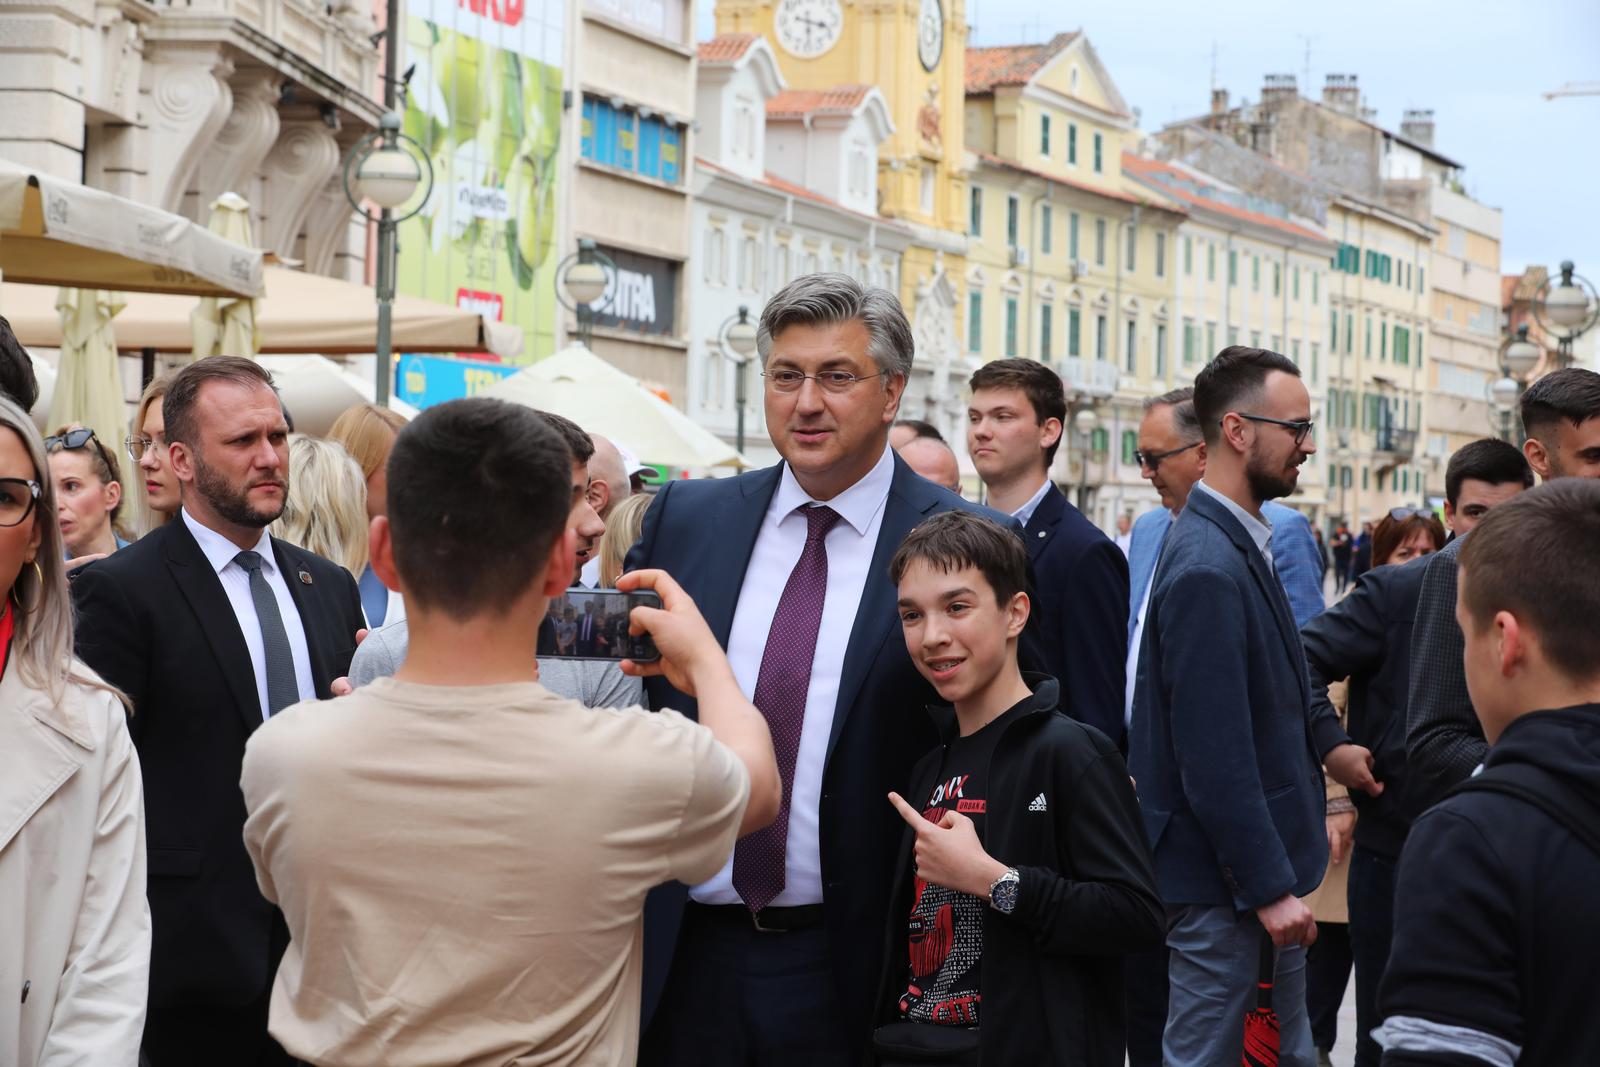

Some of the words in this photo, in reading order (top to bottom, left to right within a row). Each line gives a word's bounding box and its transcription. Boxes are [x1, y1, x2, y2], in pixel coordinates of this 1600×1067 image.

[928, 774, 970, 806] ONX
[1028, 804, 1047, 812] adid
[932, 995, 983, 1024] CIT
